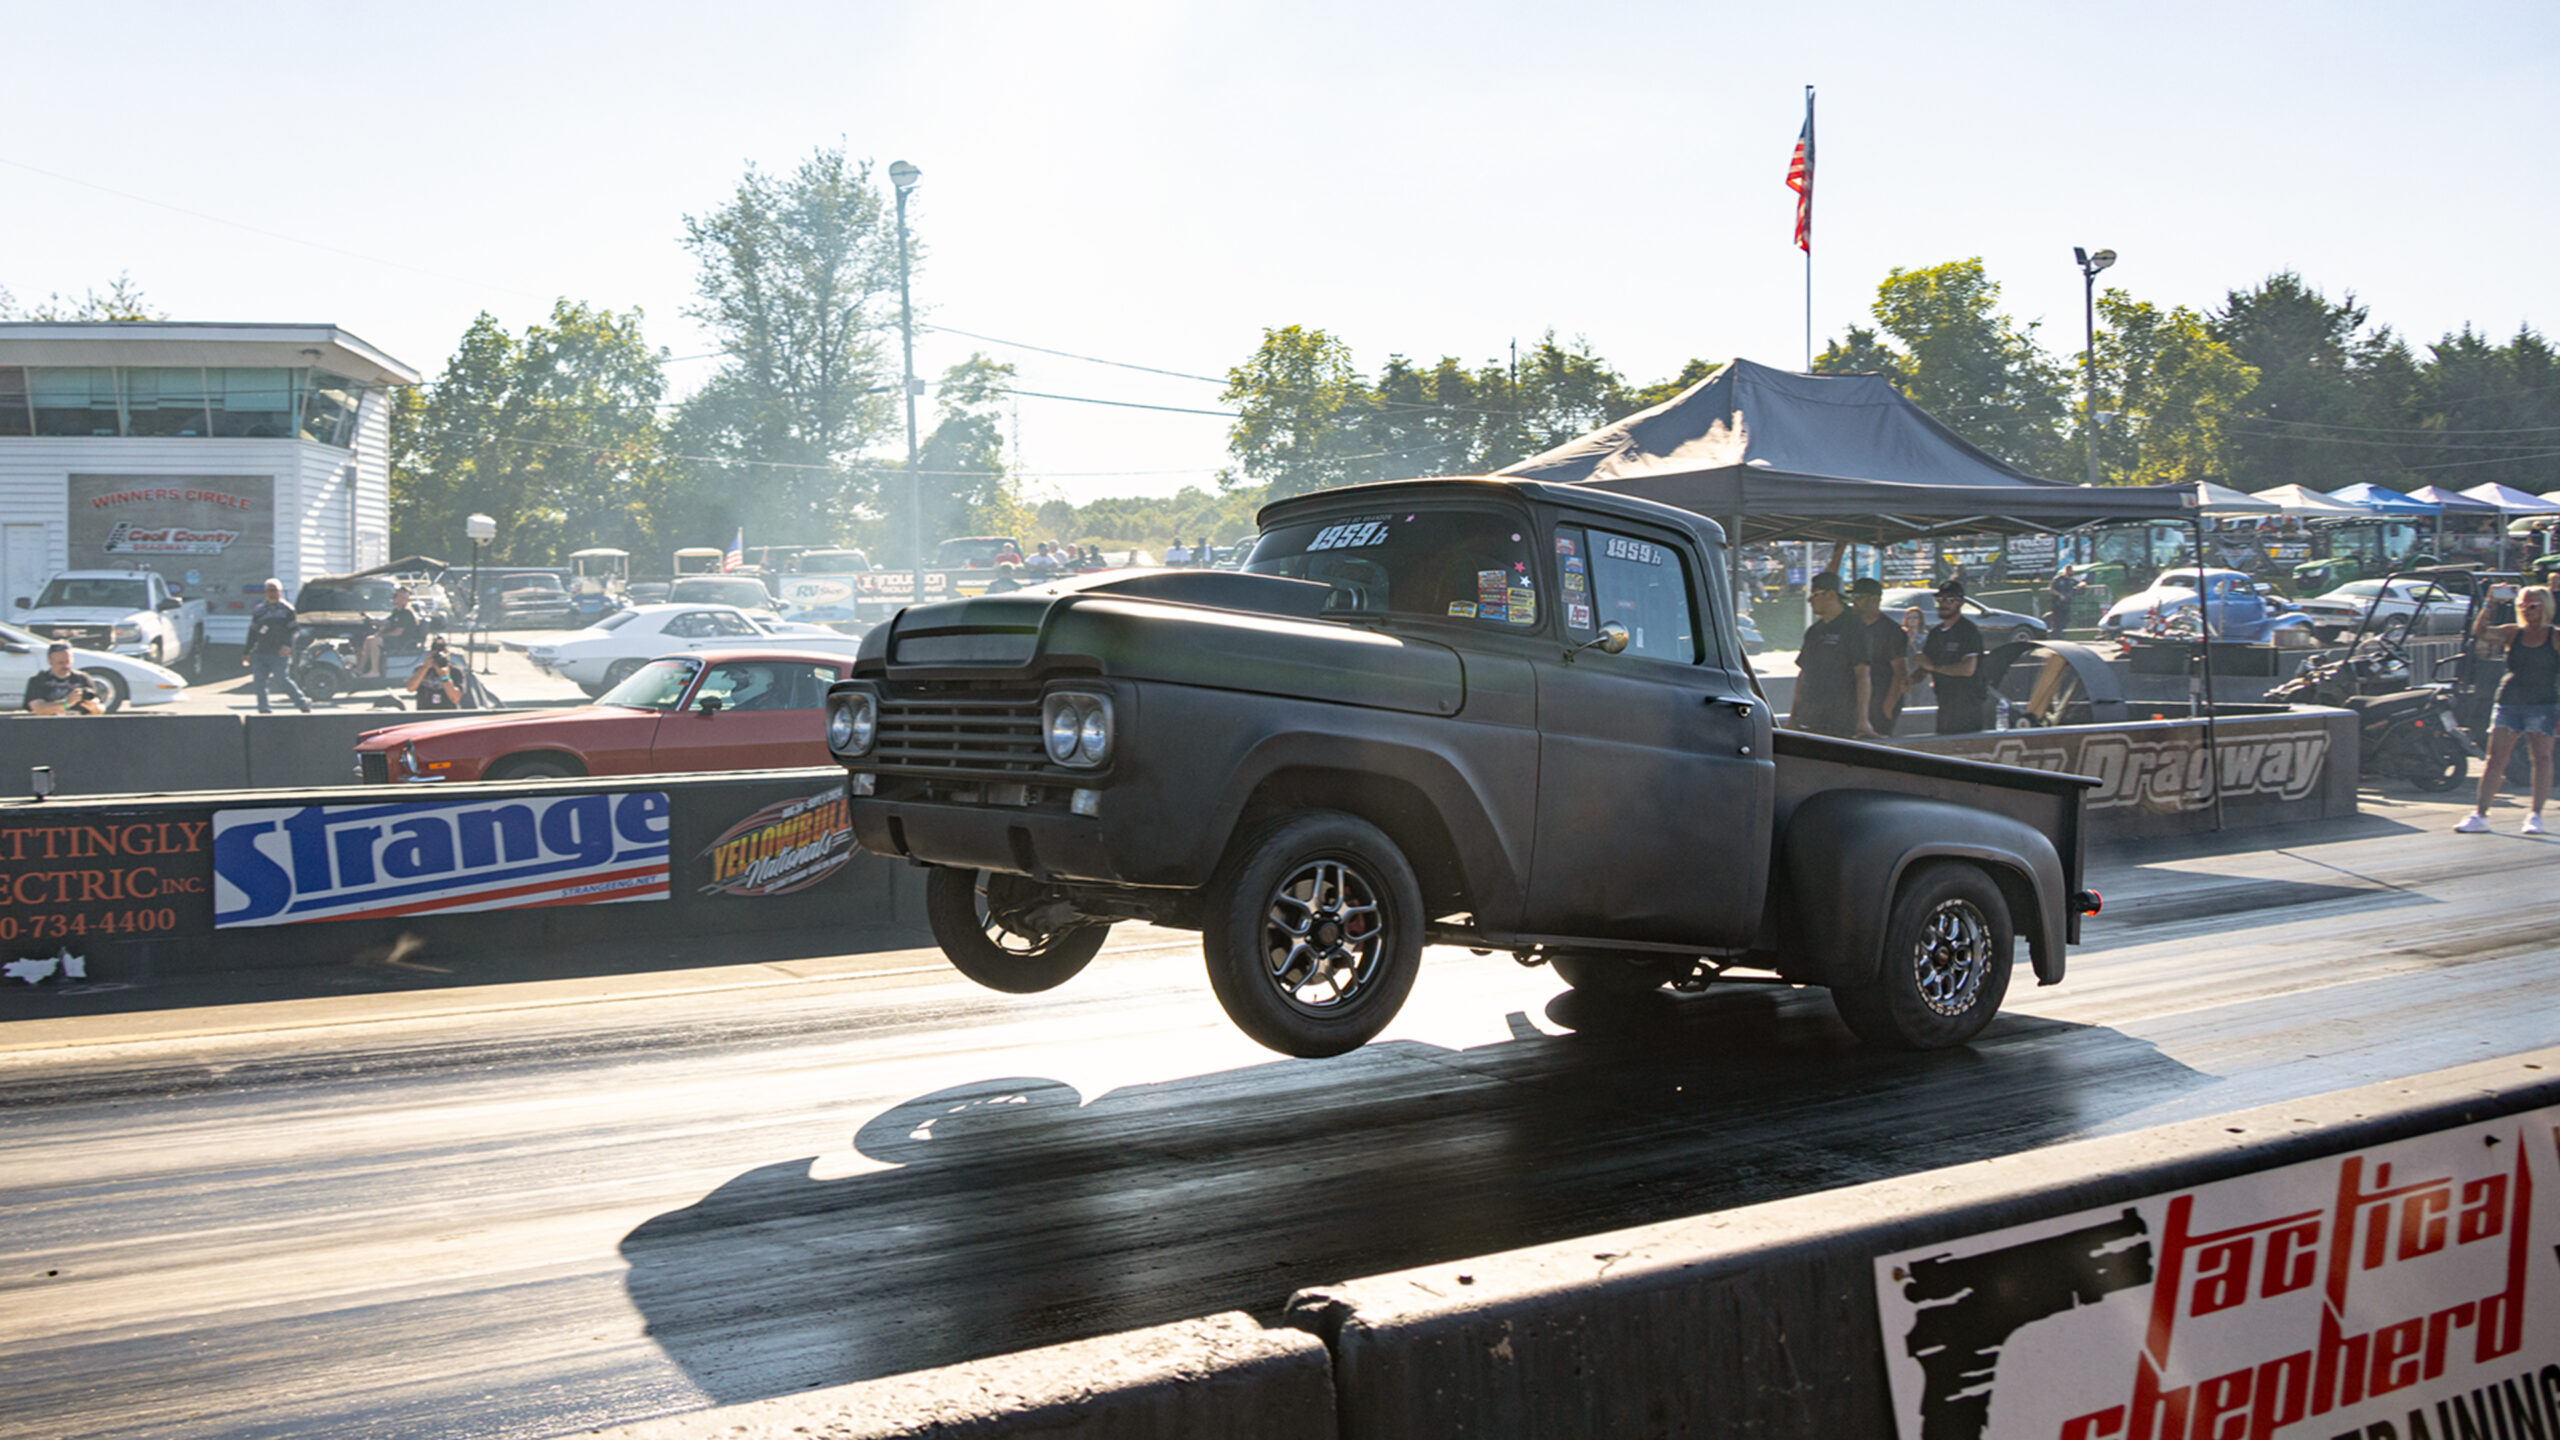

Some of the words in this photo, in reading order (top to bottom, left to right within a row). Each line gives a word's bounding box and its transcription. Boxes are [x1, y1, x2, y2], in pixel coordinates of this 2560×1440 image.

[90, 488, 180, 509] WINNERS
[184, 489, 251, 511] CIRCLE
[173, 531, 236, 544] County
[2080, 734, 2328, 806] Dragway
[0, 821, 209, 860] TTINGLY
[214, 791, 670, 920] Strange
[714, 797, 852, 882] YELLOWBULL
[744, 828, 833, 889] Nationals
[160, 877, 206, 895] INC.
[560, 875, 657, 898] STRANGEENG.NET
[0, 907, 176, 940] 0-734-4400
[2330, 1363, 2560, 1440] AINING
